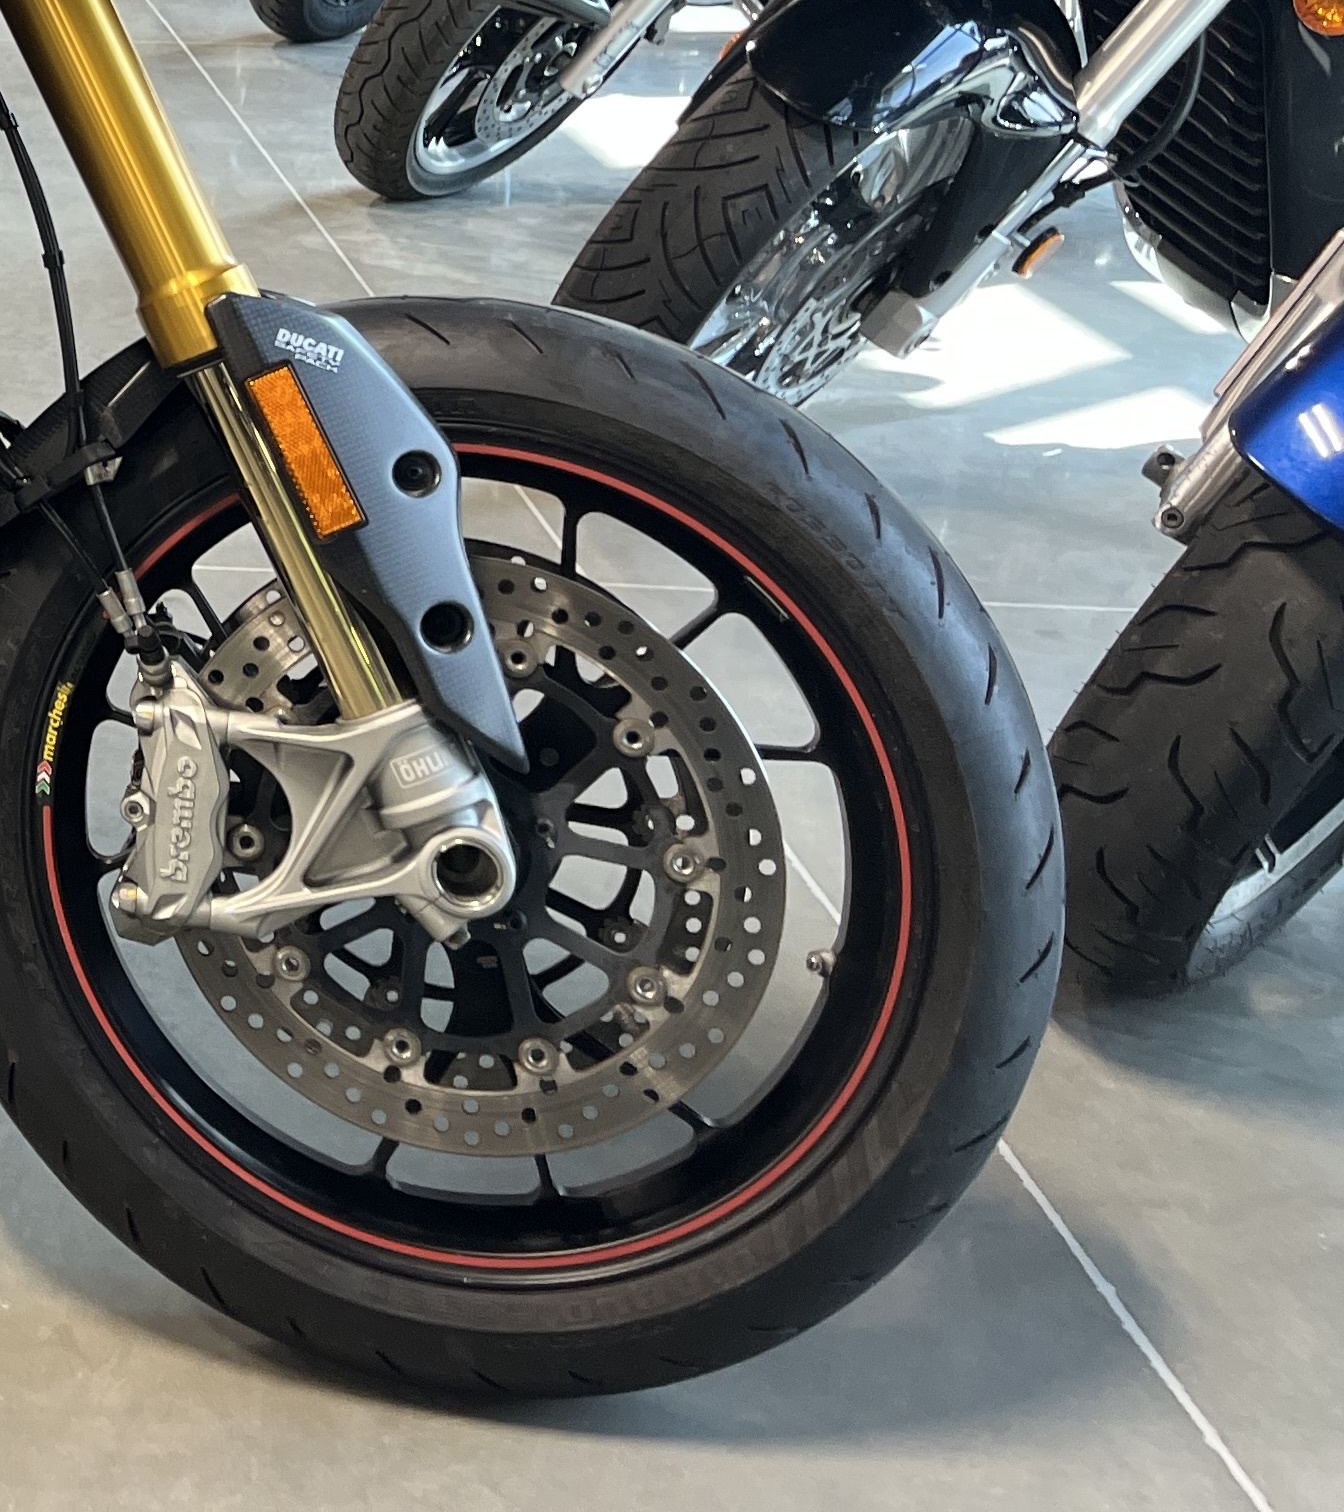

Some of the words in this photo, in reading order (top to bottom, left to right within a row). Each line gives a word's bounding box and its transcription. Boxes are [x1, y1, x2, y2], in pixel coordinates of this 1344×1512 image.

[276, 327, 345, 362] DUCATI
[294, 353, 338, 374] PACK
[159, 755, 199, 883] brembo
